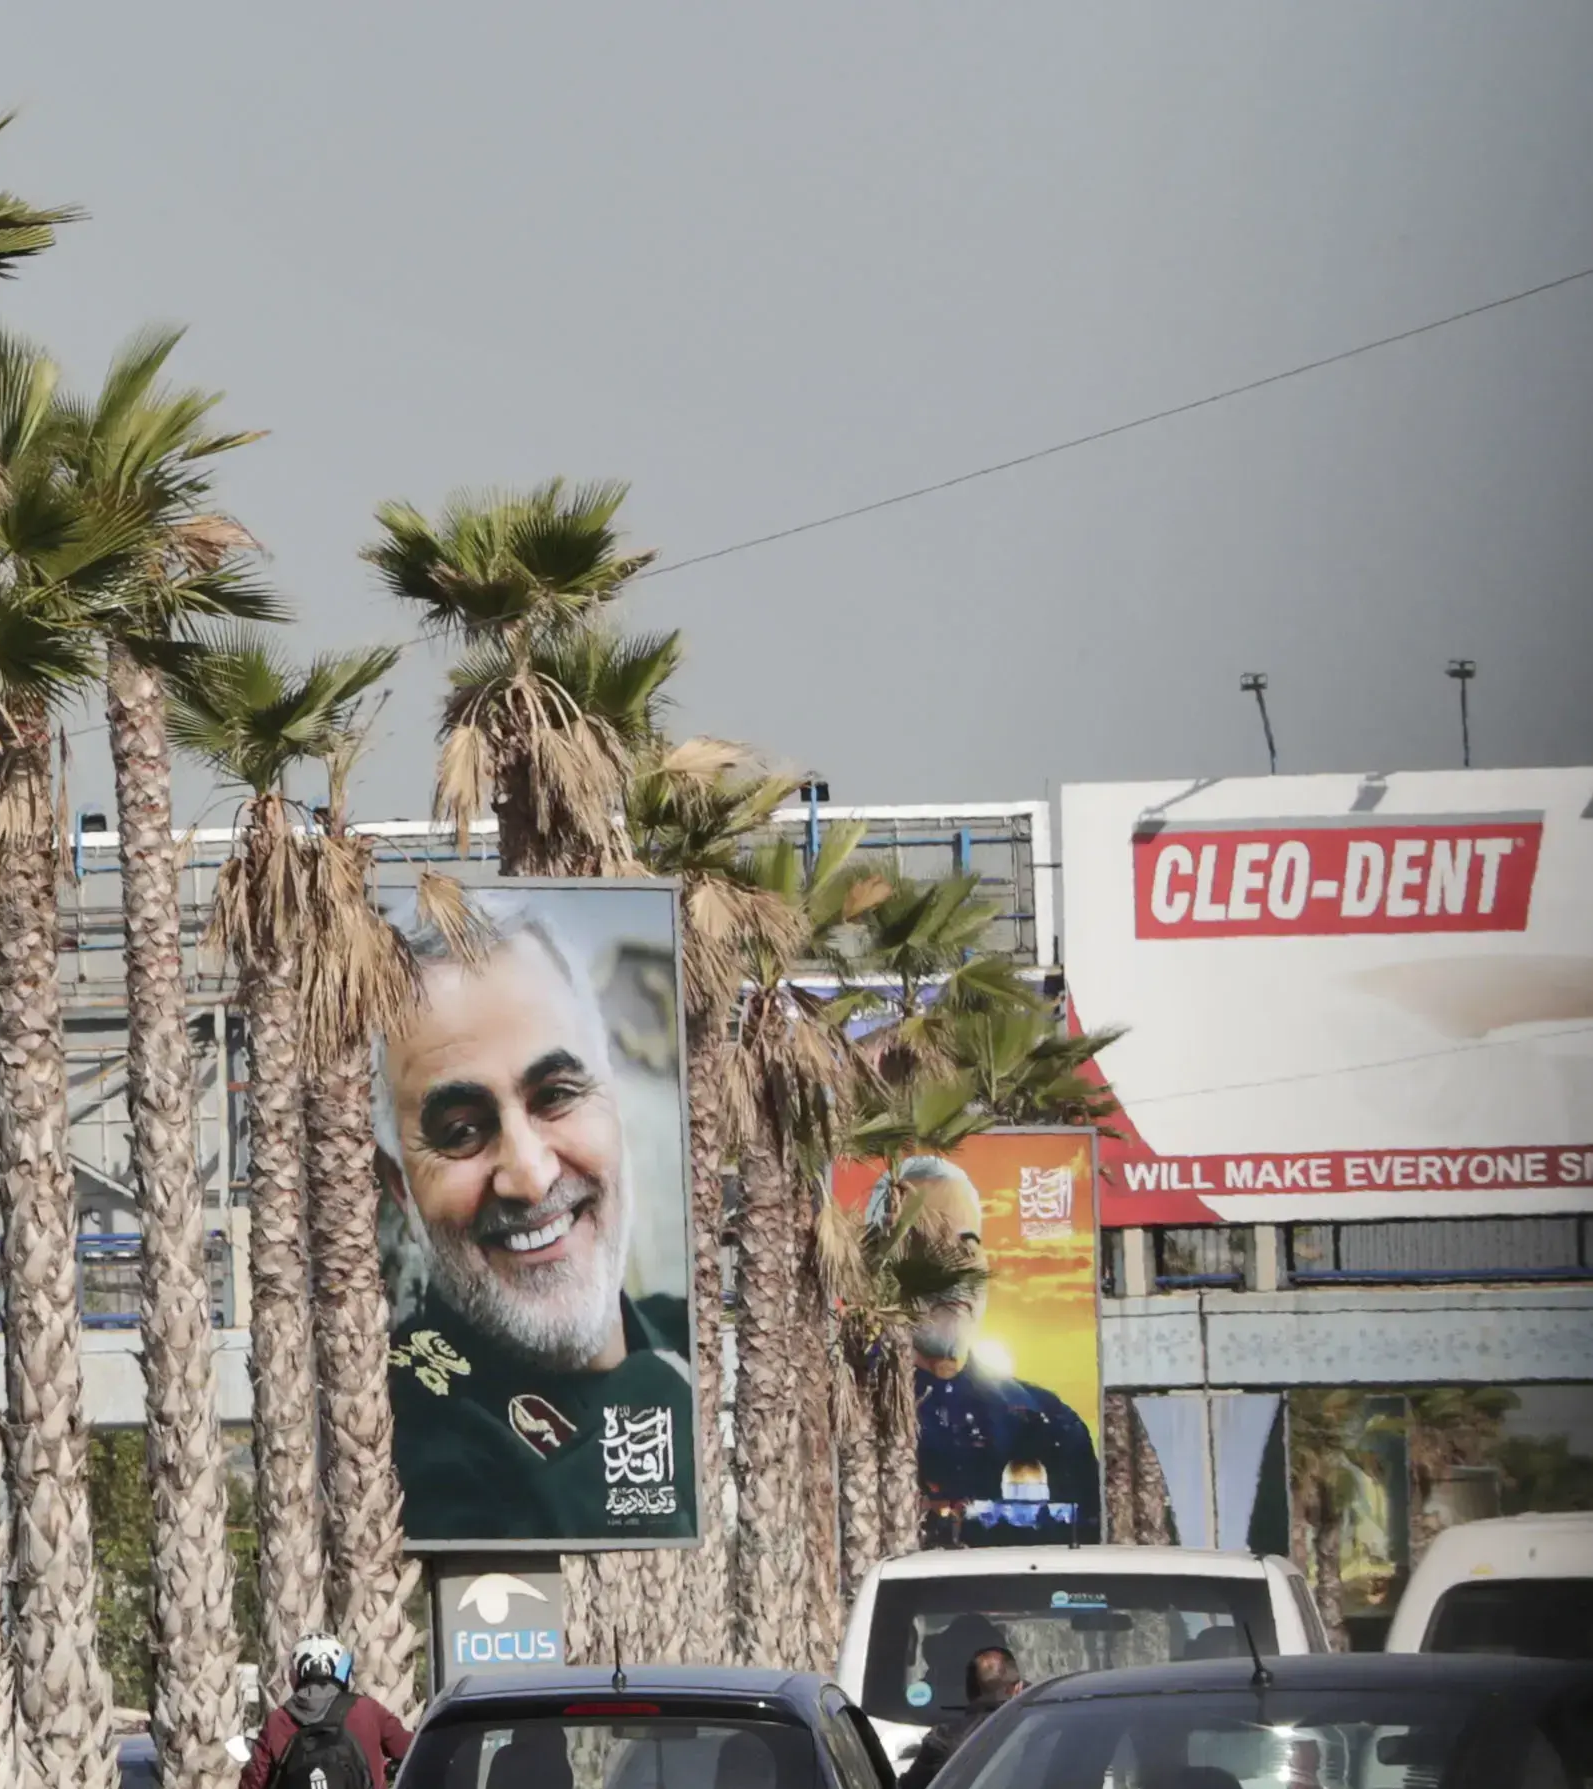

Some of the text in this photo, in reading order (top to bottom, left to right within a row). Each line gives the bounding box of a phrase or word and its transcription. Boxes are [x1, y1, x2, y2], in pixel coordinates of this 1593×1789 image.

[1150, 838, 1512, 924] CLEO-DENT
[1124, 1162, 1215, 1192] WILL
[1225, 1157, 1332, 1190] MAKE
[1345, 1153, 1548, 1186] EVERYONE
